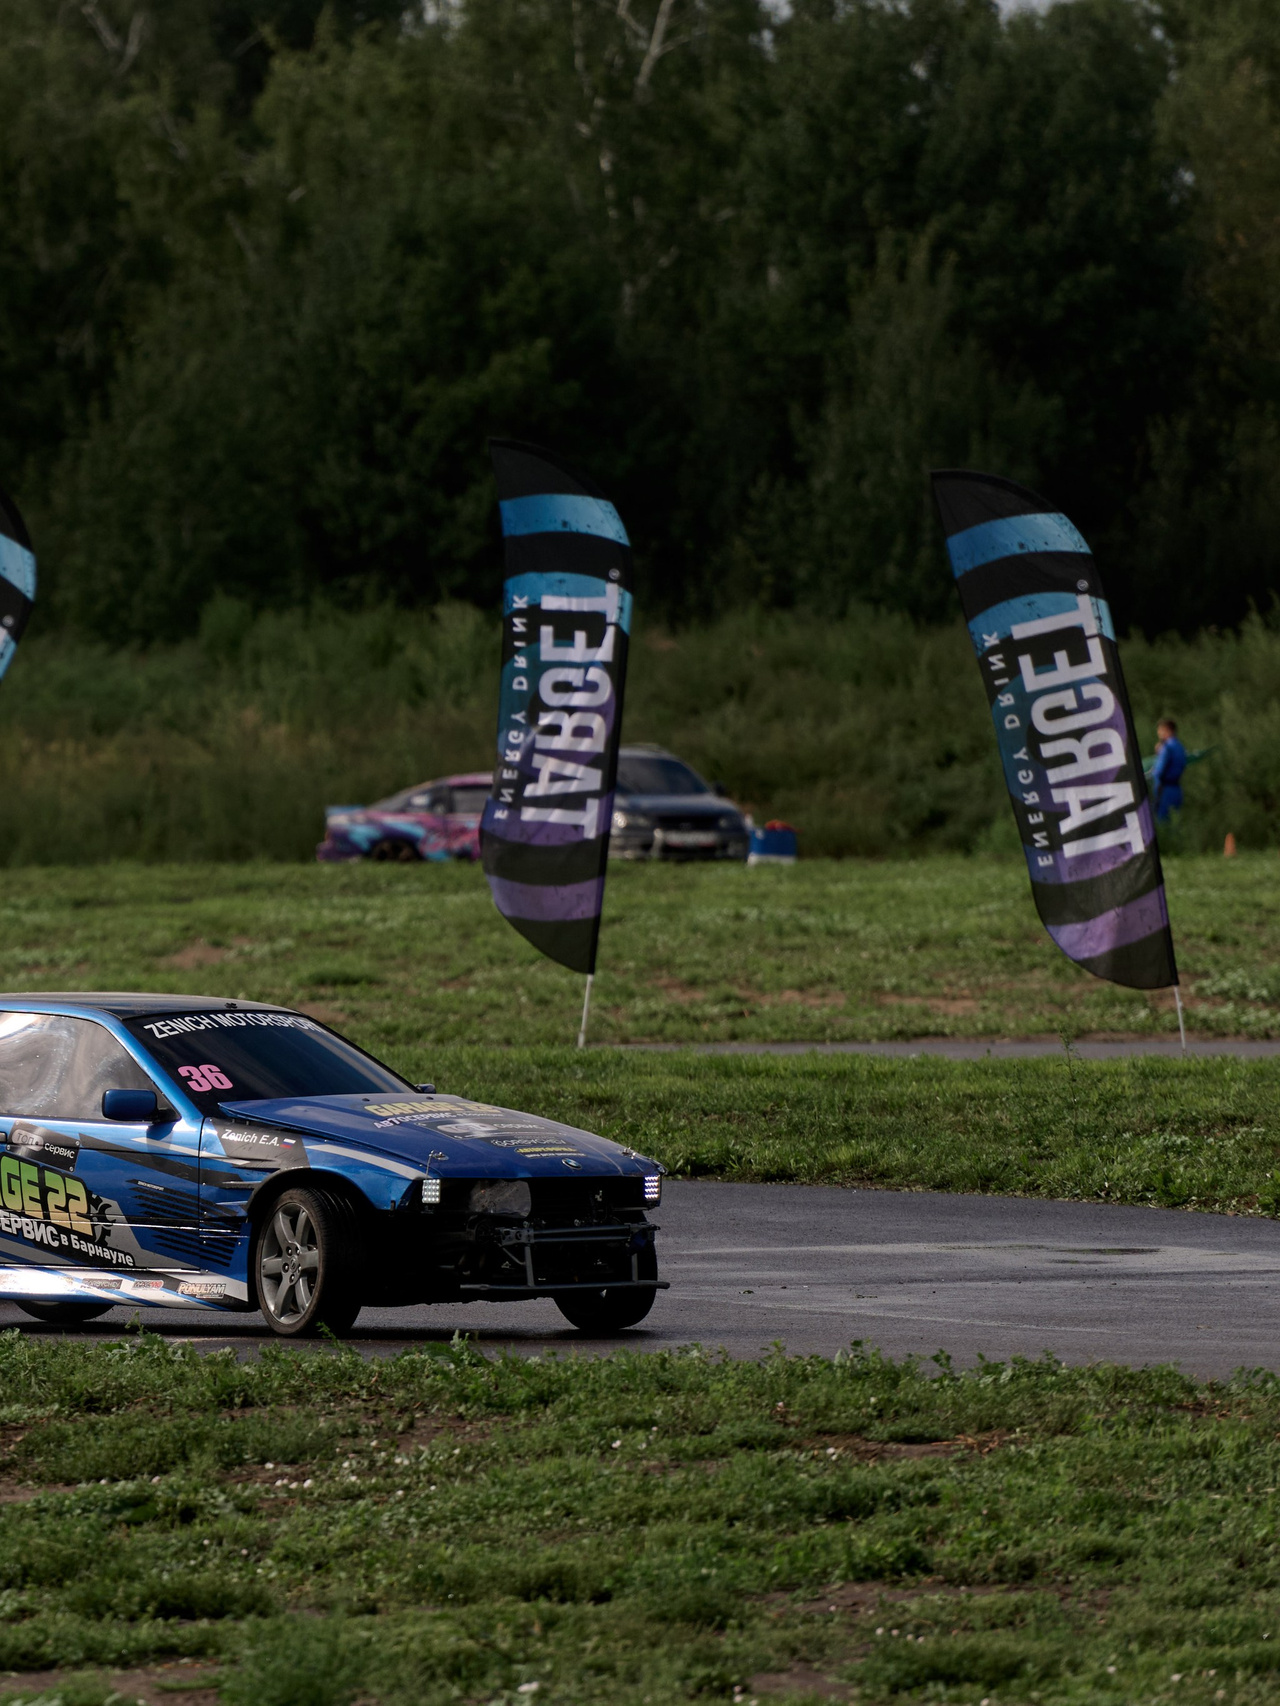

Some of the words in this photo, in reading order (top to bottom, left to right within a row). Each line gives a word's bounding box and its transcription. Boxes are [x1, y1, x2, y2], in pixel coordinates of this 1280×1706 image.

[143, 1014, 220, 1040] ZENICH
[177, 1064, 234, 1092] 36
[364, 1101, 465, 1117] GARAGE
[16, 1131, 34, 1146] ТОП
[44, 1142, 75, 1160] сервис
[221, 1128, 257, 1144] Zenich
[258, 1134, 280, 1146] E.A.
[44, 1169, 94, 1236] 22
[60, 1234, 69, 1246] в
[71, 1235, 135, 1267] Барнауле
